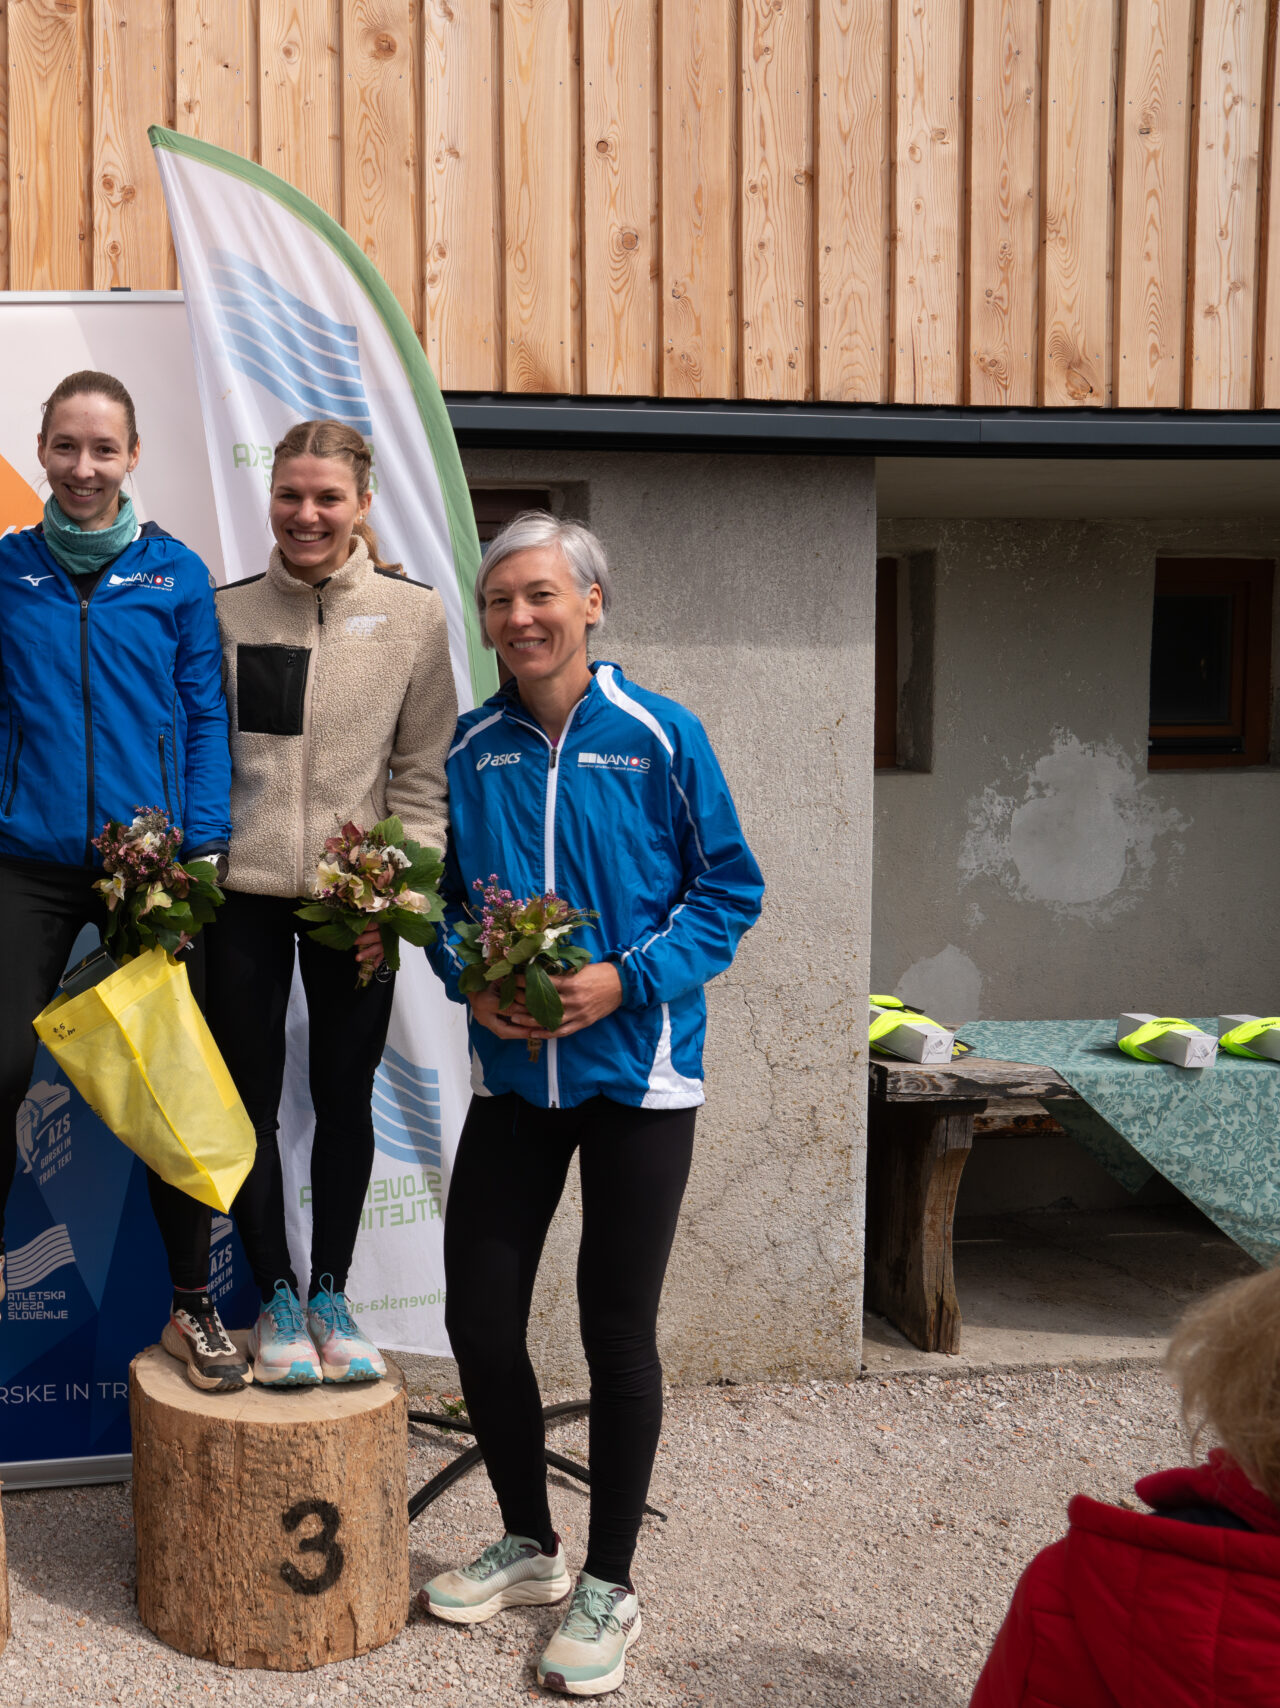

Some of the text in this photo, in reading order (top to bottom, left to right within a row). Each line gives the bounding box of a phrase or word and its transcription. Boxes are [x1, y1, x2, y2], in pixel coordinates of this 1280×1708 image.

[48, 1113, 71, 1147] AZS
[39, 1150, 72, 1186] TRAIL TEKI
[41, 1136, 72, 1170] GORSKI IN
[210, 1243, 233, 1277] AZS
[206, 1264, 233, 1294] ORSKI IN
[219, 1278, 233, 1297] TEKI
[8, 1291, 66, 1301] ATLETSKA
[8, 1301, 44, 1311] ZVEZA
[8, 1310, 69, 1320] SLOVENIJE
[66, 1383, 89, 1400] IN
[280, 1499, 344, 1595] 3
